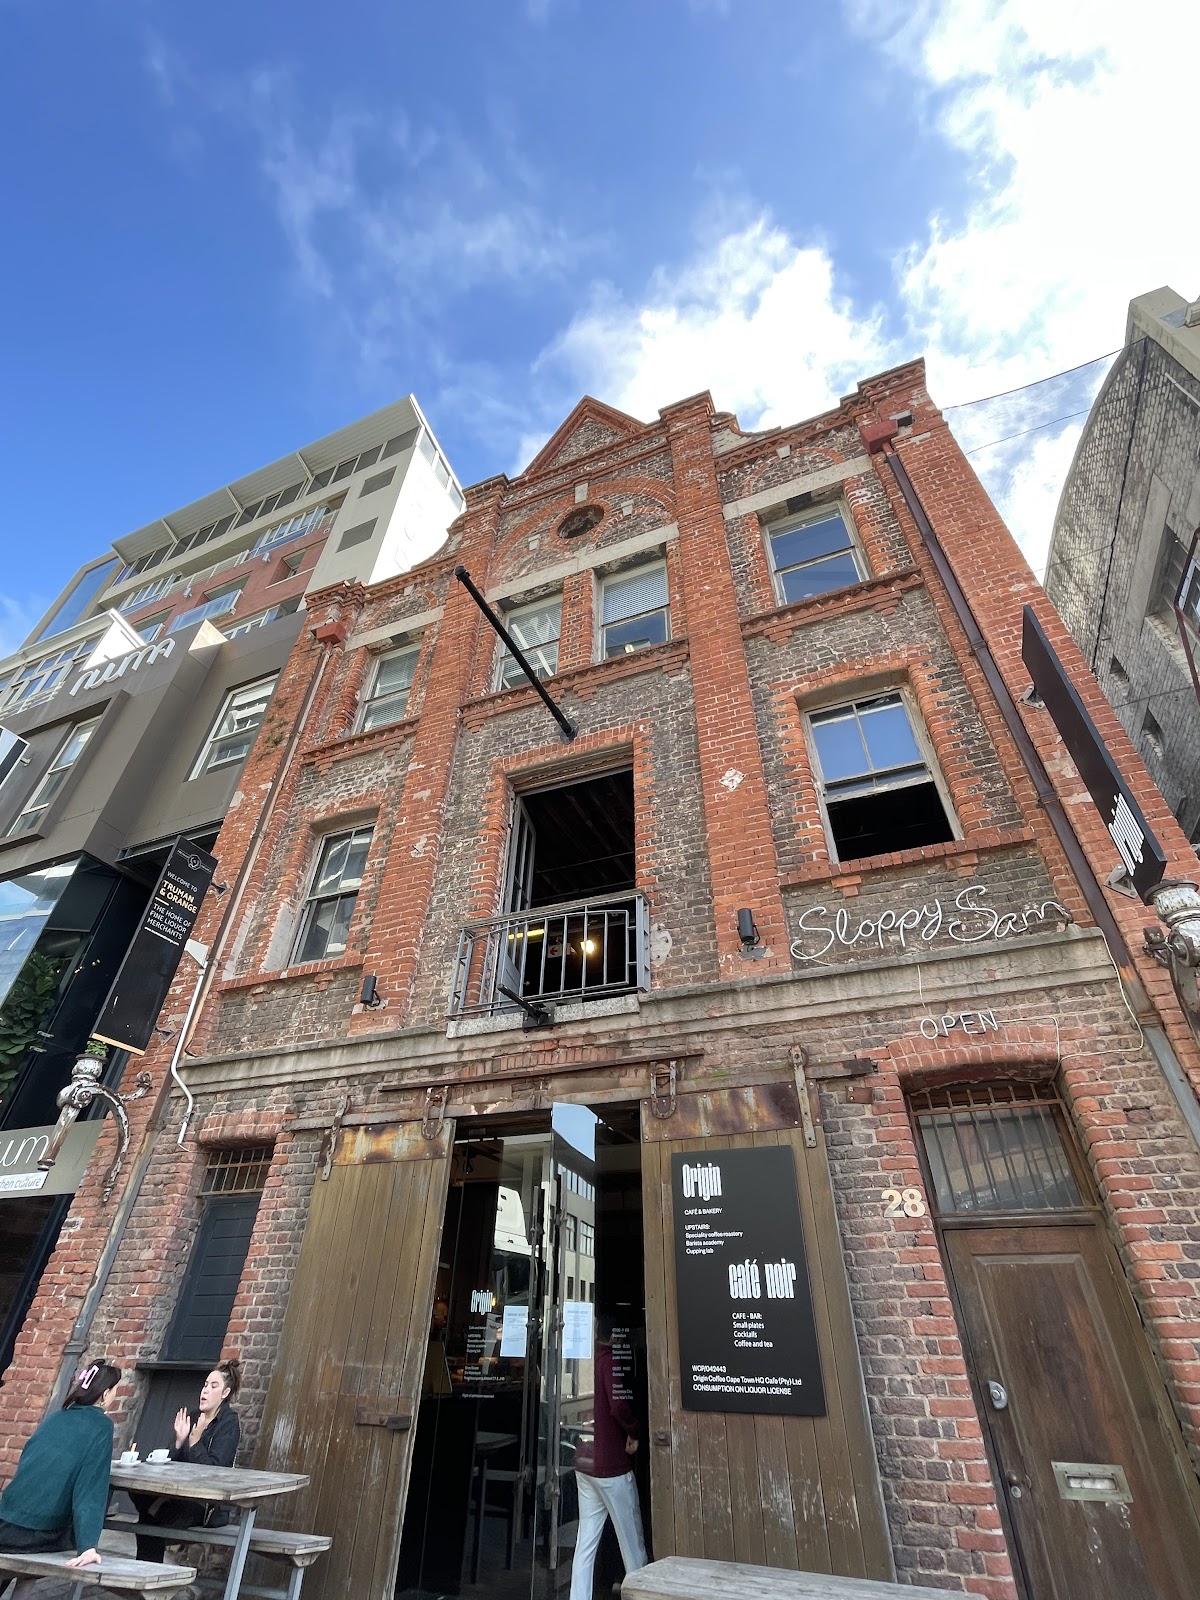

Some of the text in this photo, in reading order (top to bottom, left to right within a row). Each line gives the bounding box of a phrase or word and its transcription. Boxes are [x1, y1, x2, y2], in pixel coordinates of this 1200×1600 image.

[162, 880, 195, 903] TRUMAN
[167, 871, 198, 893] WELCOME TO
[159, 887, 198, 914] & ORANGE
[149, 910, 187, 934] FINE LIQUOR
[153, 902, 192, 928] THE HOME OF
[790, 885, 1068, 960] Sloppy Sam
[147, 917, 183, 940] MERCHANTS
[920, 1009, 999, 1040] OPEN
[14, 1176, 42, 1189] culture
[682, 1162, 723, 1201] Origin
[703, 1207, 723, 1215] BAKERY
[881, 1188, 926, 1218] 28
[728, 1257, 797, 1299] café noir
[470, 1289, 493, 1316] Origin
[733, 1321, 765, 1331] Small plates
[733, 1330, 758, 1339] Cocktails
[734, 1340, 774, 1348] Coffee and tea
[692, 1384, 793, 1396] CONSUMPTION ON LIQUOR LICENSE
[693, 1374, 708, 1383] Origin
[708, 1374, 726, 1382] Coffee
[726, 1375, 740, 1384] Cape
[740, 1375, 755, 1384] Town
